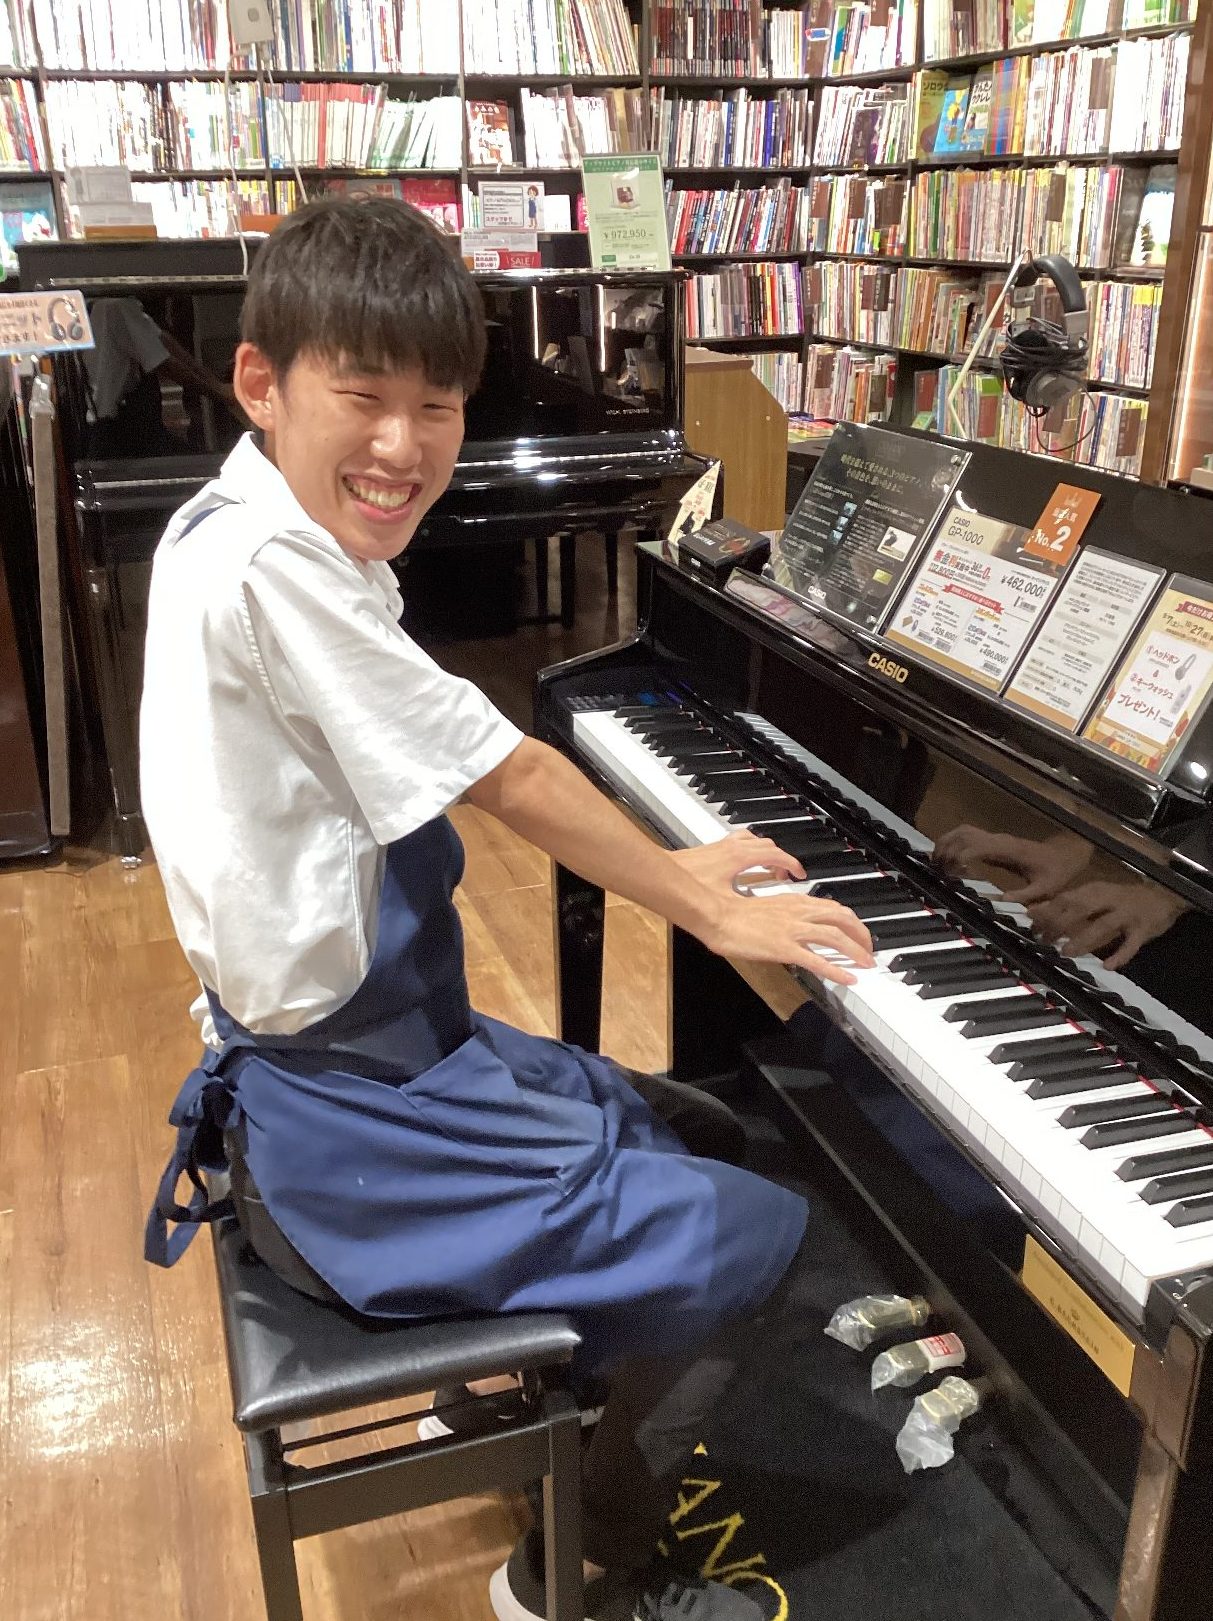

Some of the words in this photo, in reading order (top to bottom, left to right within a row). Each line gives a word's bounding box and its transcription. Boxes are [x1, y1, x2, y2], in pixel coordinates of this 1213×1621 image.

[510, 257, 530, 266] SALE
[953, 516, 971, 528] CASIO
[947, 525, 984, 546] GP-1000
[867, 652, 910, 684] CASIO
